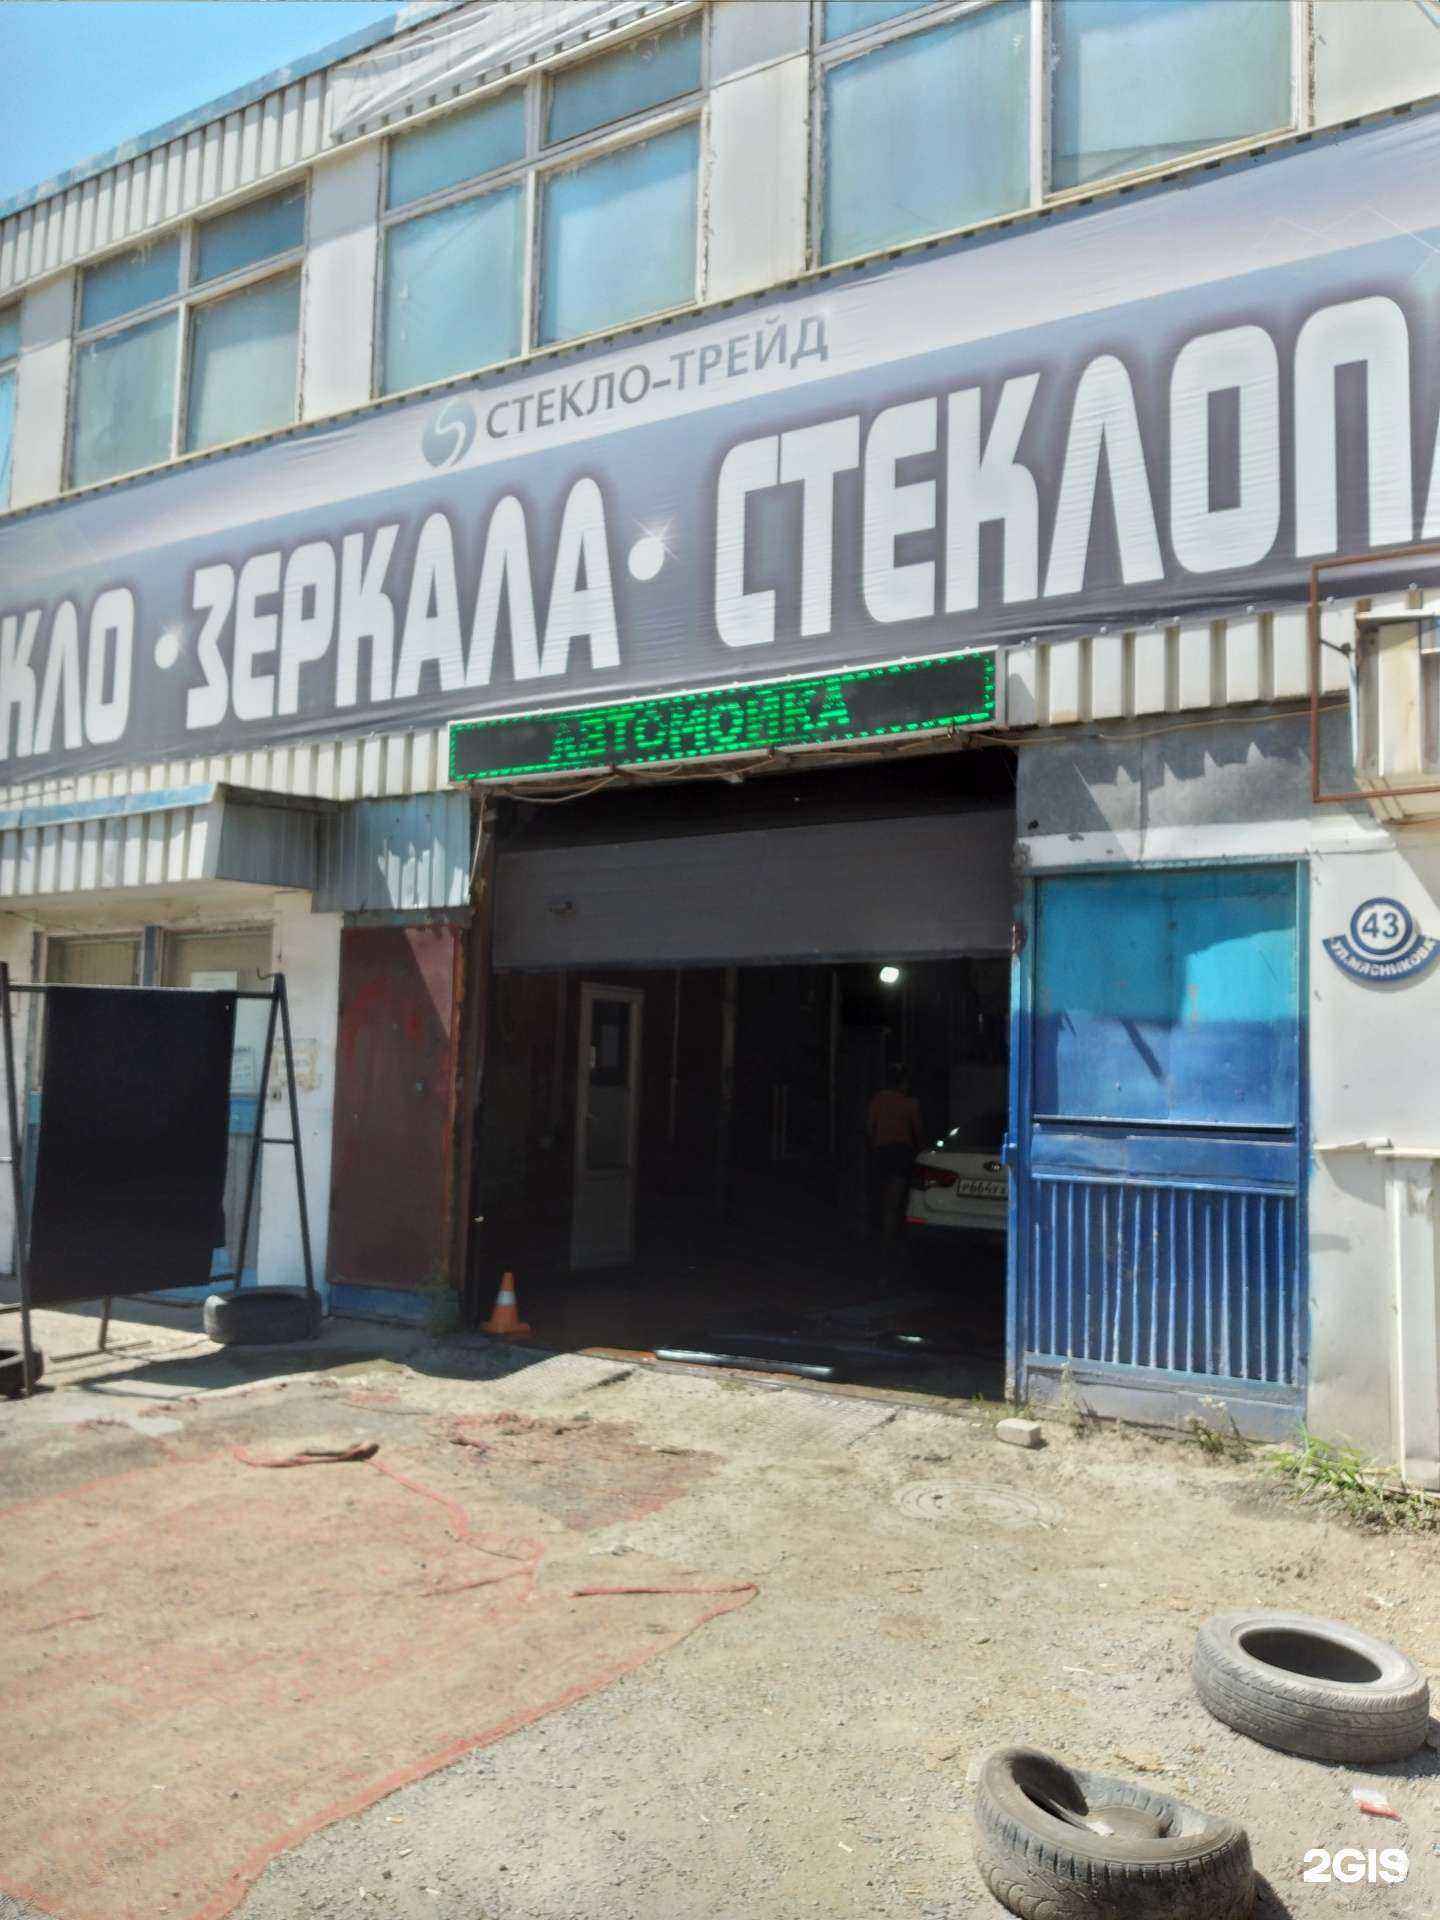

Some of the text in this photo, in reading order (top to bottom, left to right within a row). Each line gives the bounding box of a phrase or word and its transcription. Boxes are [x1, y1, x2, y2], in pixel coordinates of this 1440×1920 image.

[485, 313, 829, 440] СТЕКЛО-ТРЕЙД
[187, 478, 620, 730] ЗЕРКАЛА
[714, 296, 1440, 648] СТЕКЛОП
[1362, 912, 1399, 938] 43
